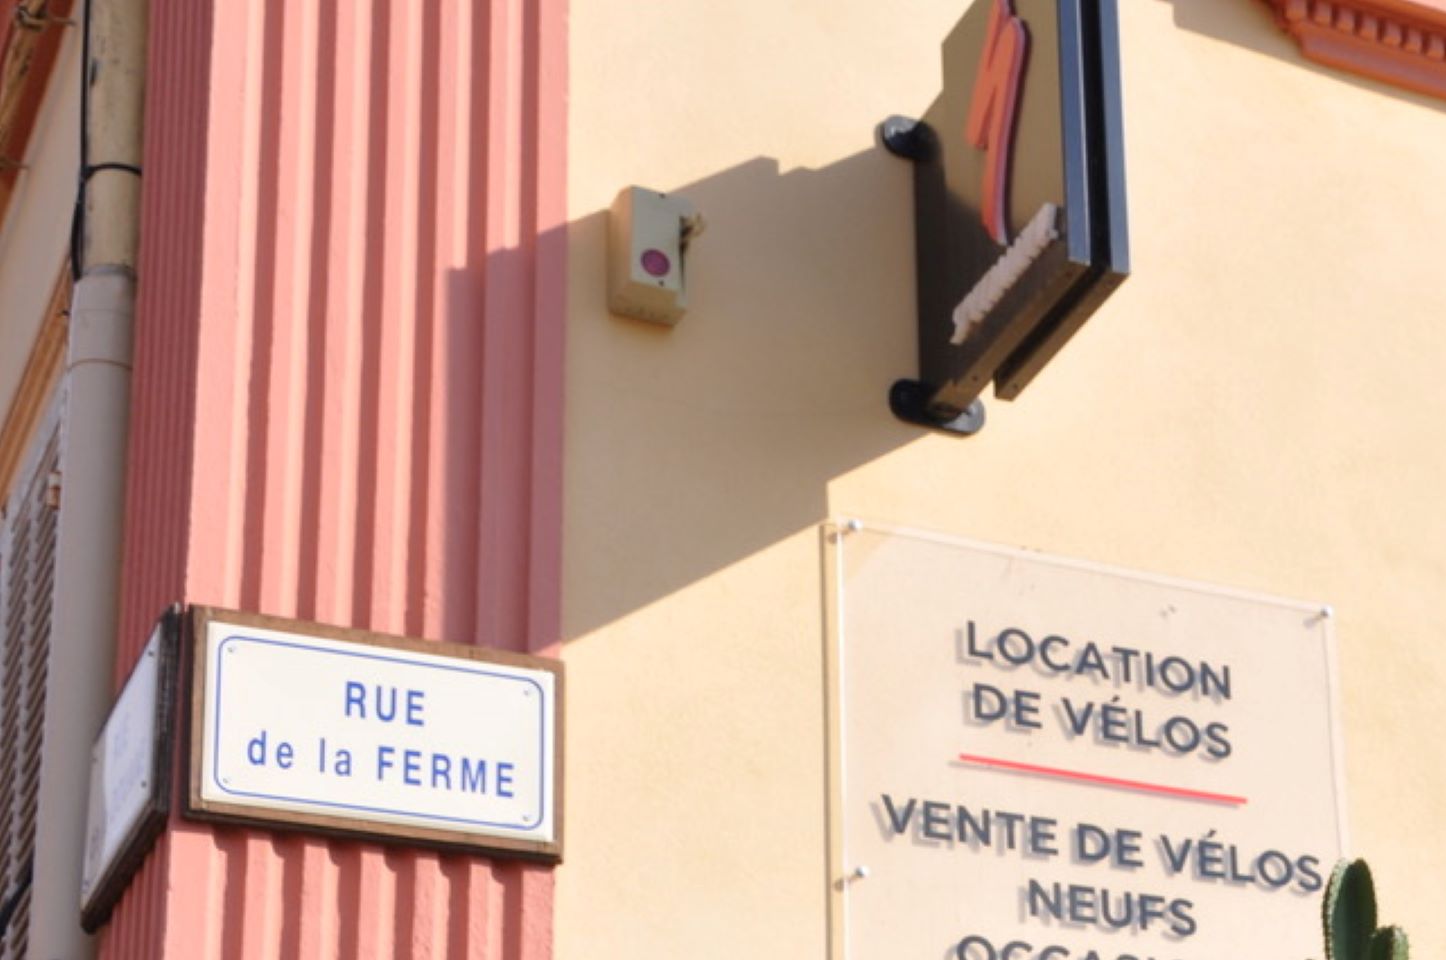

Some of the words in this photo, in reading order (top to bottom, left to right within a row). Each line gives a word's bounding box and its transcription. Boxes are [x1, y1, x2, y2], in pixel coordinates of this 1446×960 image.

[966, 620, 1231, 699] LOCATION
[344, 680, 426, 726] RUE
[972, 682, 1042, 729] DE
[1061, 697, 1231, 758] VÉLOS
[247, 731, 294, 768] de
[319, 739, 352, 775] la
[377, 747, 515, 798] FERME
[882, 794, 1060, 855] VENTE
[1077, 823, 1145, 867] DE
[1160, 829, 1323, 893] VÉLOS
[1028, 879, 1197, 935] NEUFS
